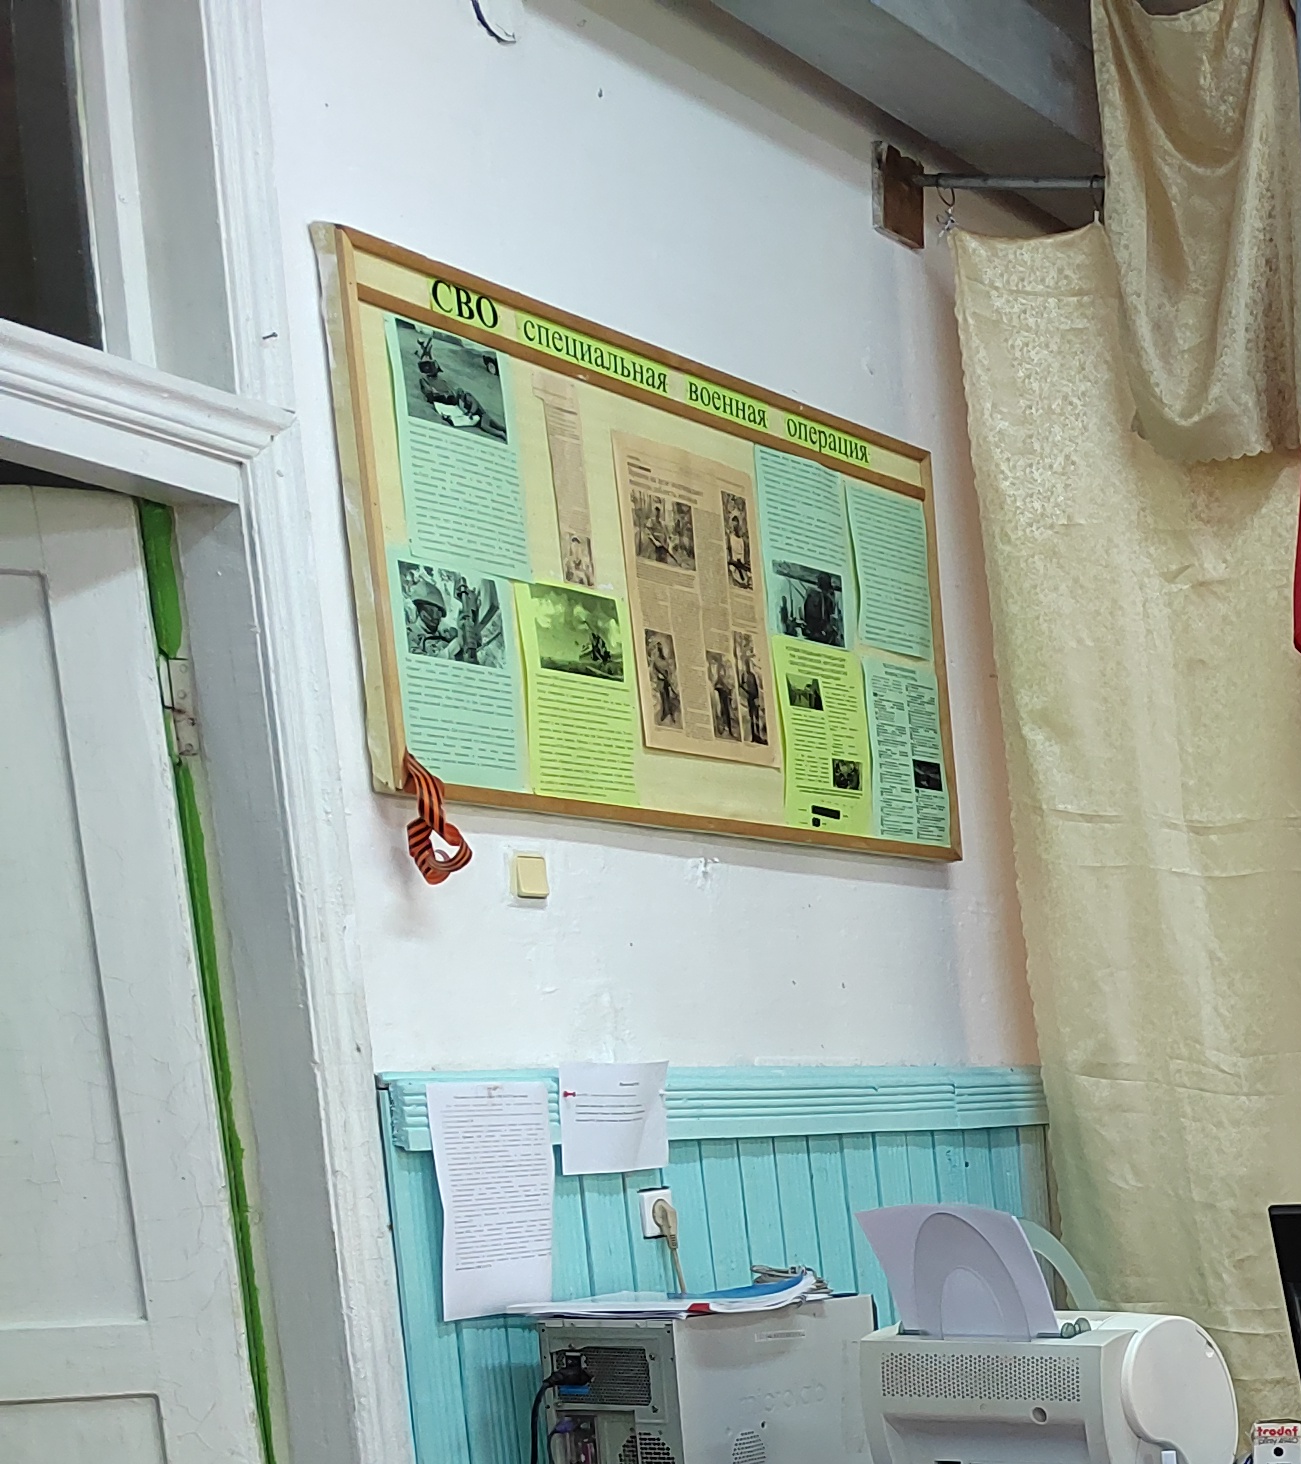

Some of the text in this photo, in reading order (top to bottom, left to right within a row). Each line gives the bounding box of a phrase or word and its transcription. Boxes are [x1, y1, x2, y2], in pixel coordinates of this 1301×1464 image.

[432, 279, 870, 464] СВО специальная военная операция
[1257, 1426, 1298, 1437] trodat
